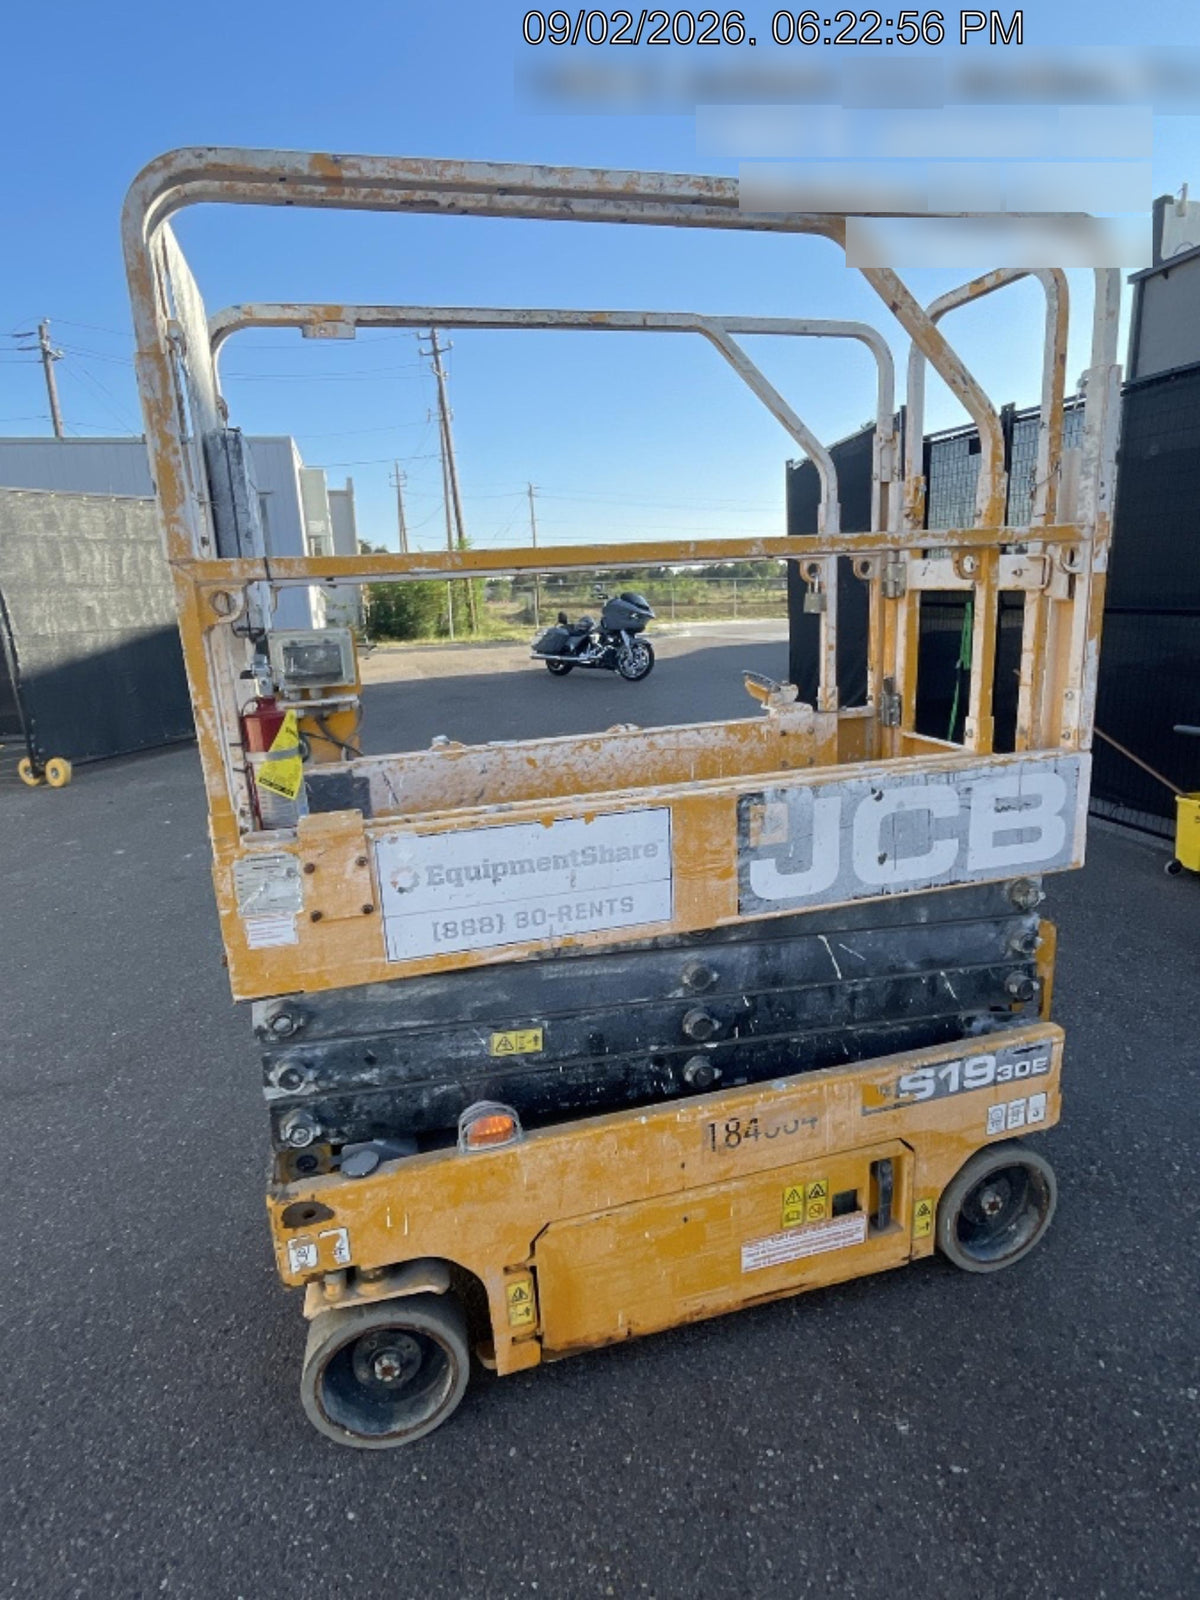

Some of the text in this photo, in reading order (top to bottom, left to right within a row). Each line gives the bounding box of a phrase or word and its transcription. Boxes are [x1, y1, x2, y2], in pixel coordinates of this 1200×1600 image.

[750, 772, 1067, 900] JCB
[425, 842, 658, 887] EquipmentShare
[899, 1055, 1048, 1100] S19 30E
